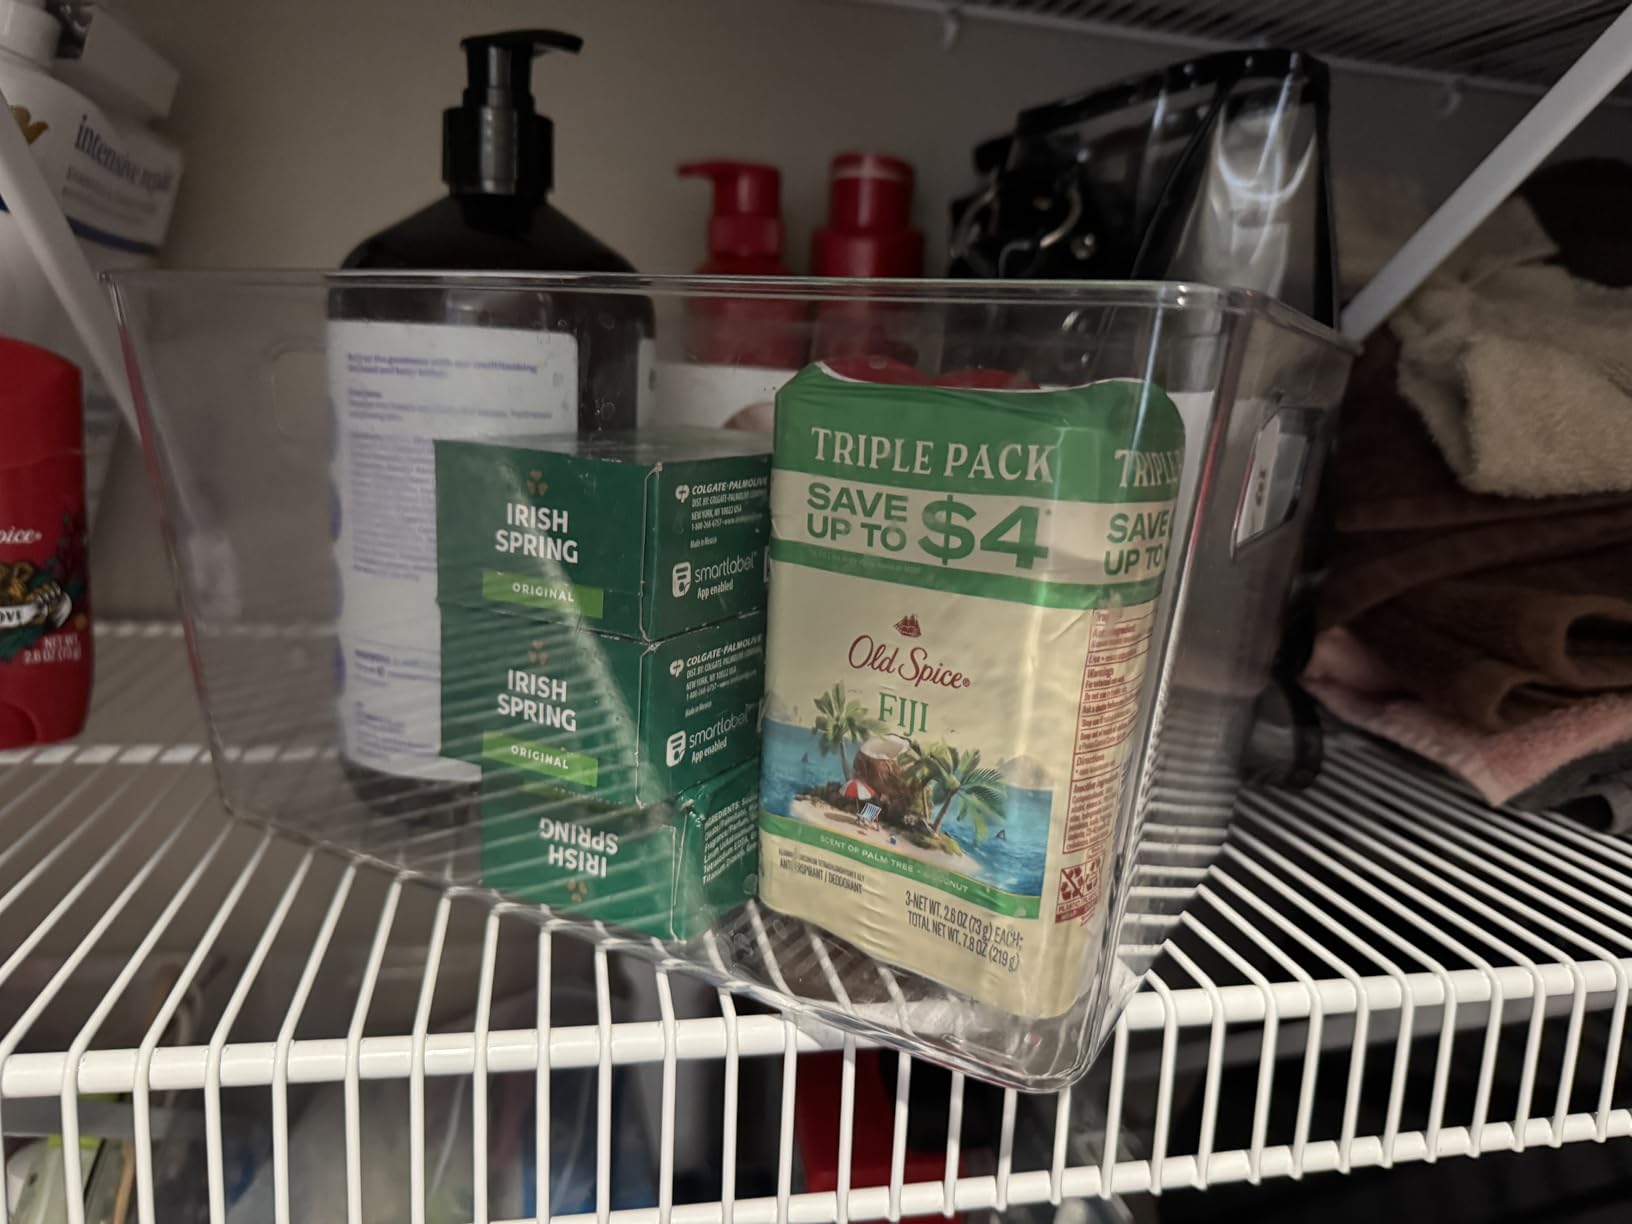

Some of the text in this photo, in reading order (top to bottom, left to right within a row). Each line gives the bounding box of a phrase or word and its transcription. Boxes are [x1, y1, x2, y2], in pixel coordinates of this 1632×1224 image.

[811, 427, 1054, 484] TRIPLE PACK
[506, 502, 570, 533] IRISH
[806, 482, 909, 523] SAVE
[806, 513, 907, 552] UP TO
[1106, 508, 1170, 544] SAVE
[495, 530, 579, 563] SPRING
[1104, 548, 1140, 576] UP
[512, 581, 575, 602] ORIGINAL
[697, 578, 734, 600] App enabled
[848, 635, 899, 674] Old
[507, 669, 567, 702] IRISH
[497, 694, 577, 732] SPRING
[878, 692, 928, 737] FIJI
[511, 744, 569, 769] ORIGINAL
[692, 736, 728, 764] App enabled
[539, 816, 619, 855] SPRING
[548, 844, 607, 878] IRISH
[819, 835, 847, 849] SCENT
[848, 843, 861, 854] OF
[862, 849, 888, 864] PALM
[890, 859, 914, 874] TREE
[905, 890, 929, 912] 3-NET
[929, 898, 943, 919] WT.
[944, 905, 957, 925] 2.6
[957, 911, 968, 929] OZ
[908, 910, 931, 933] TOTAL
[932, 919, 947, 939] NET
[947, 925, 961, 946] WT.
[963, 932, 975, 952] 7.8
[976, 939, 988, 957] OZ
[988, 944, 1009, 967] (219
